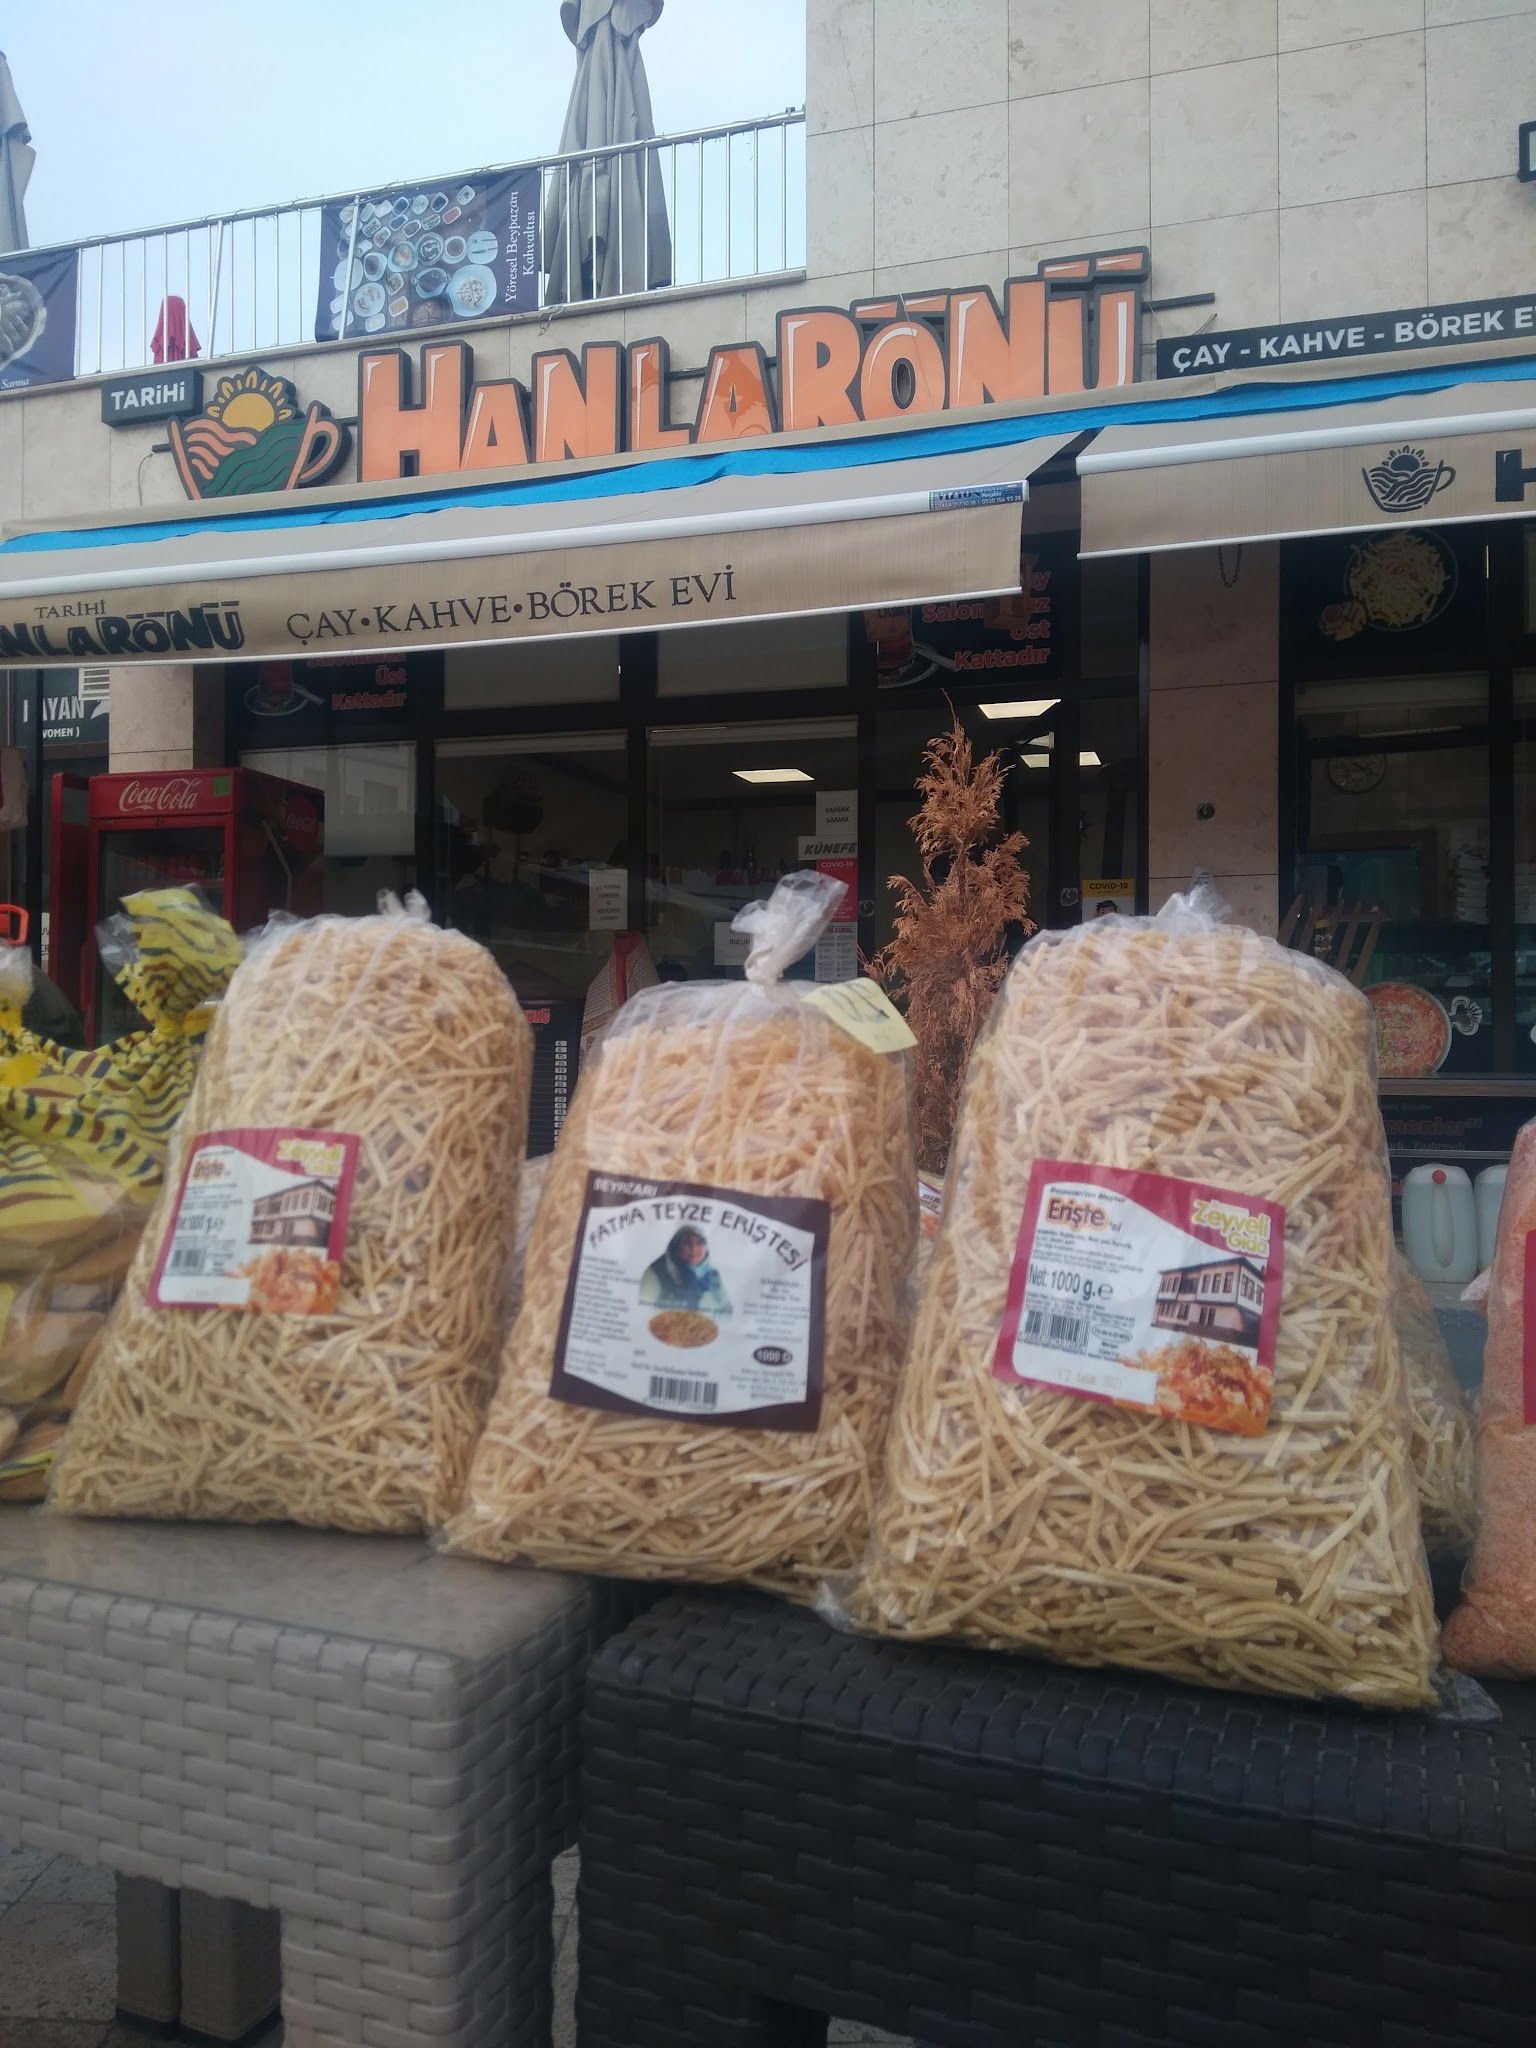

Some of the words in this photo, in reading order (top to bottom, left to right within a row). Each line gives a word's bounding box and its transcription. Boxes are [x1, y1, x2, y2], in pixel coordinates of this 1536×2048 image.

[522, 210, 535, 276] Kahvaltısı
[505, 257, 518, 303] Yöresel
[1172, 342, 1232, 373] ÇAY
[1259, 326, 1366, 359] KAHVE
[1394, 309, 1505, 343] BÖREK
[357, 246, 1149, 483] HANLARÖNÜ
[669, 563, 737, 607] EVİ
[119, 778, 201, 811] Coca-Cola
[1089, 882, 1129, 890] COVID-19
[651, 1201, 713, 1224] TEYZE
[1051, 1270, 1081, 1294] 1000
